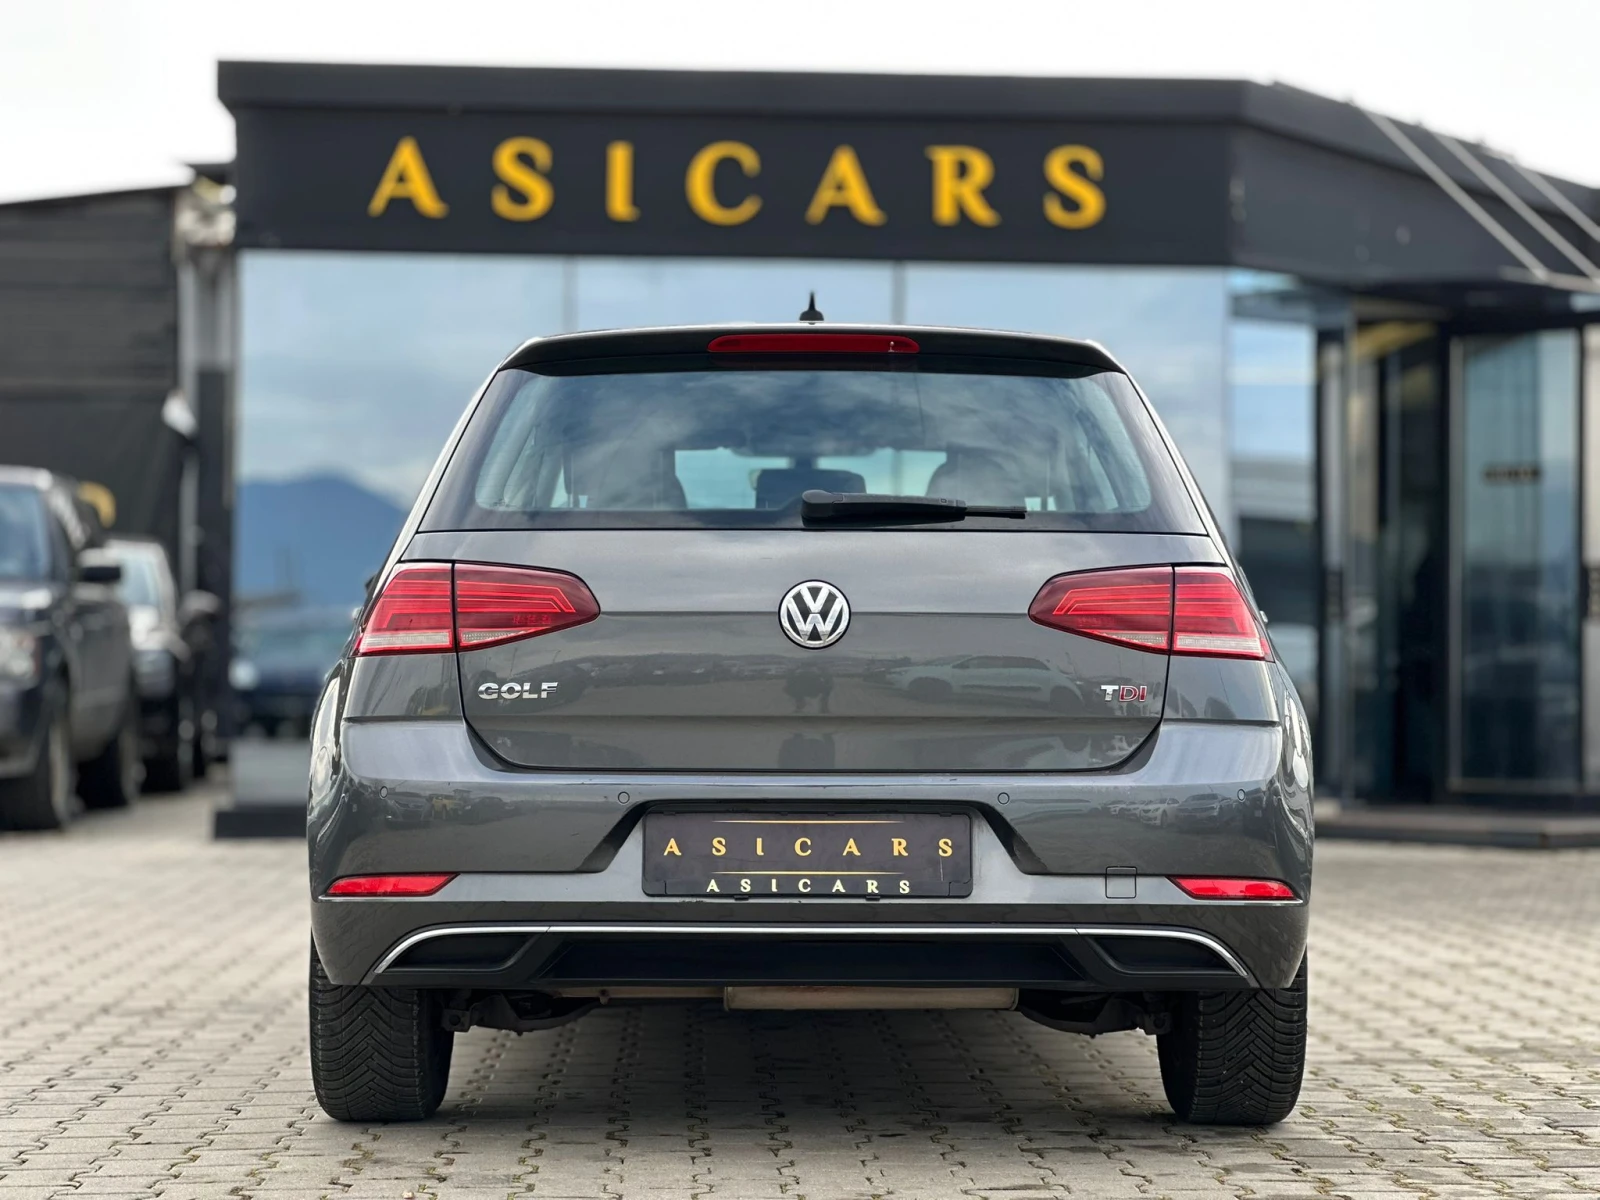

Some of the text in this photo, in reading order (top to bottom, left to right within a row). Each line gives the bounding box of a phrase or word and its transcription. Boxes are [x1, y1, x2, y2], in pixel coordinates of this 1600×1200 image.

[367, 135, 1108, 230] ASICARS
[781, 581, 848, 647] VW
[477, 681, 559, 700] GOLF
[1100, 684, 1148, 702] TDI
[663, 837, 953, 857] ASICARS
